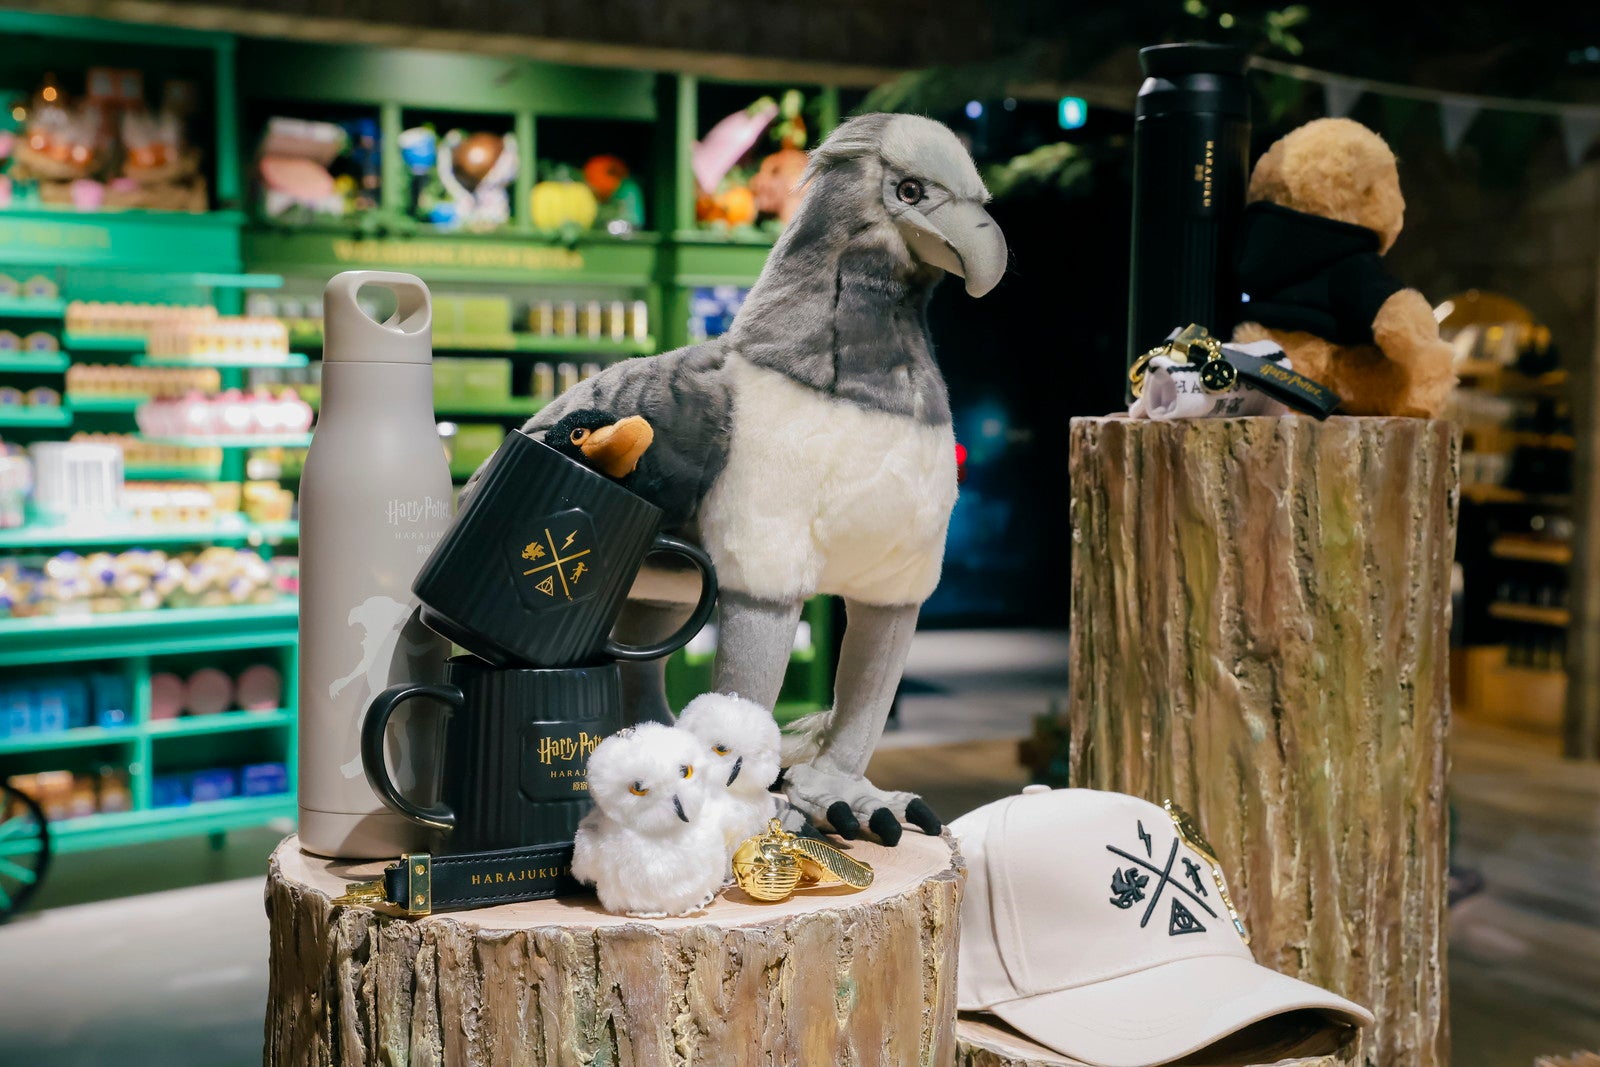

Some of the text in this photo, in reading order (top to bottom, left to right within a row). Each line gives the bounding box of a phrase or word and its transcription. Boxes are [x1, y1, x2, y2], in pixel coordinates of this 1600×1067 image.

[384, 496, 449, 526] Harry Potter
[394, 531, 444, 540] HARAJUK
[537, 736, 578, 765] Harry
[550, 768, 587, 778] HARAJ
[471, 866, 558, 885] HARAJUKU
